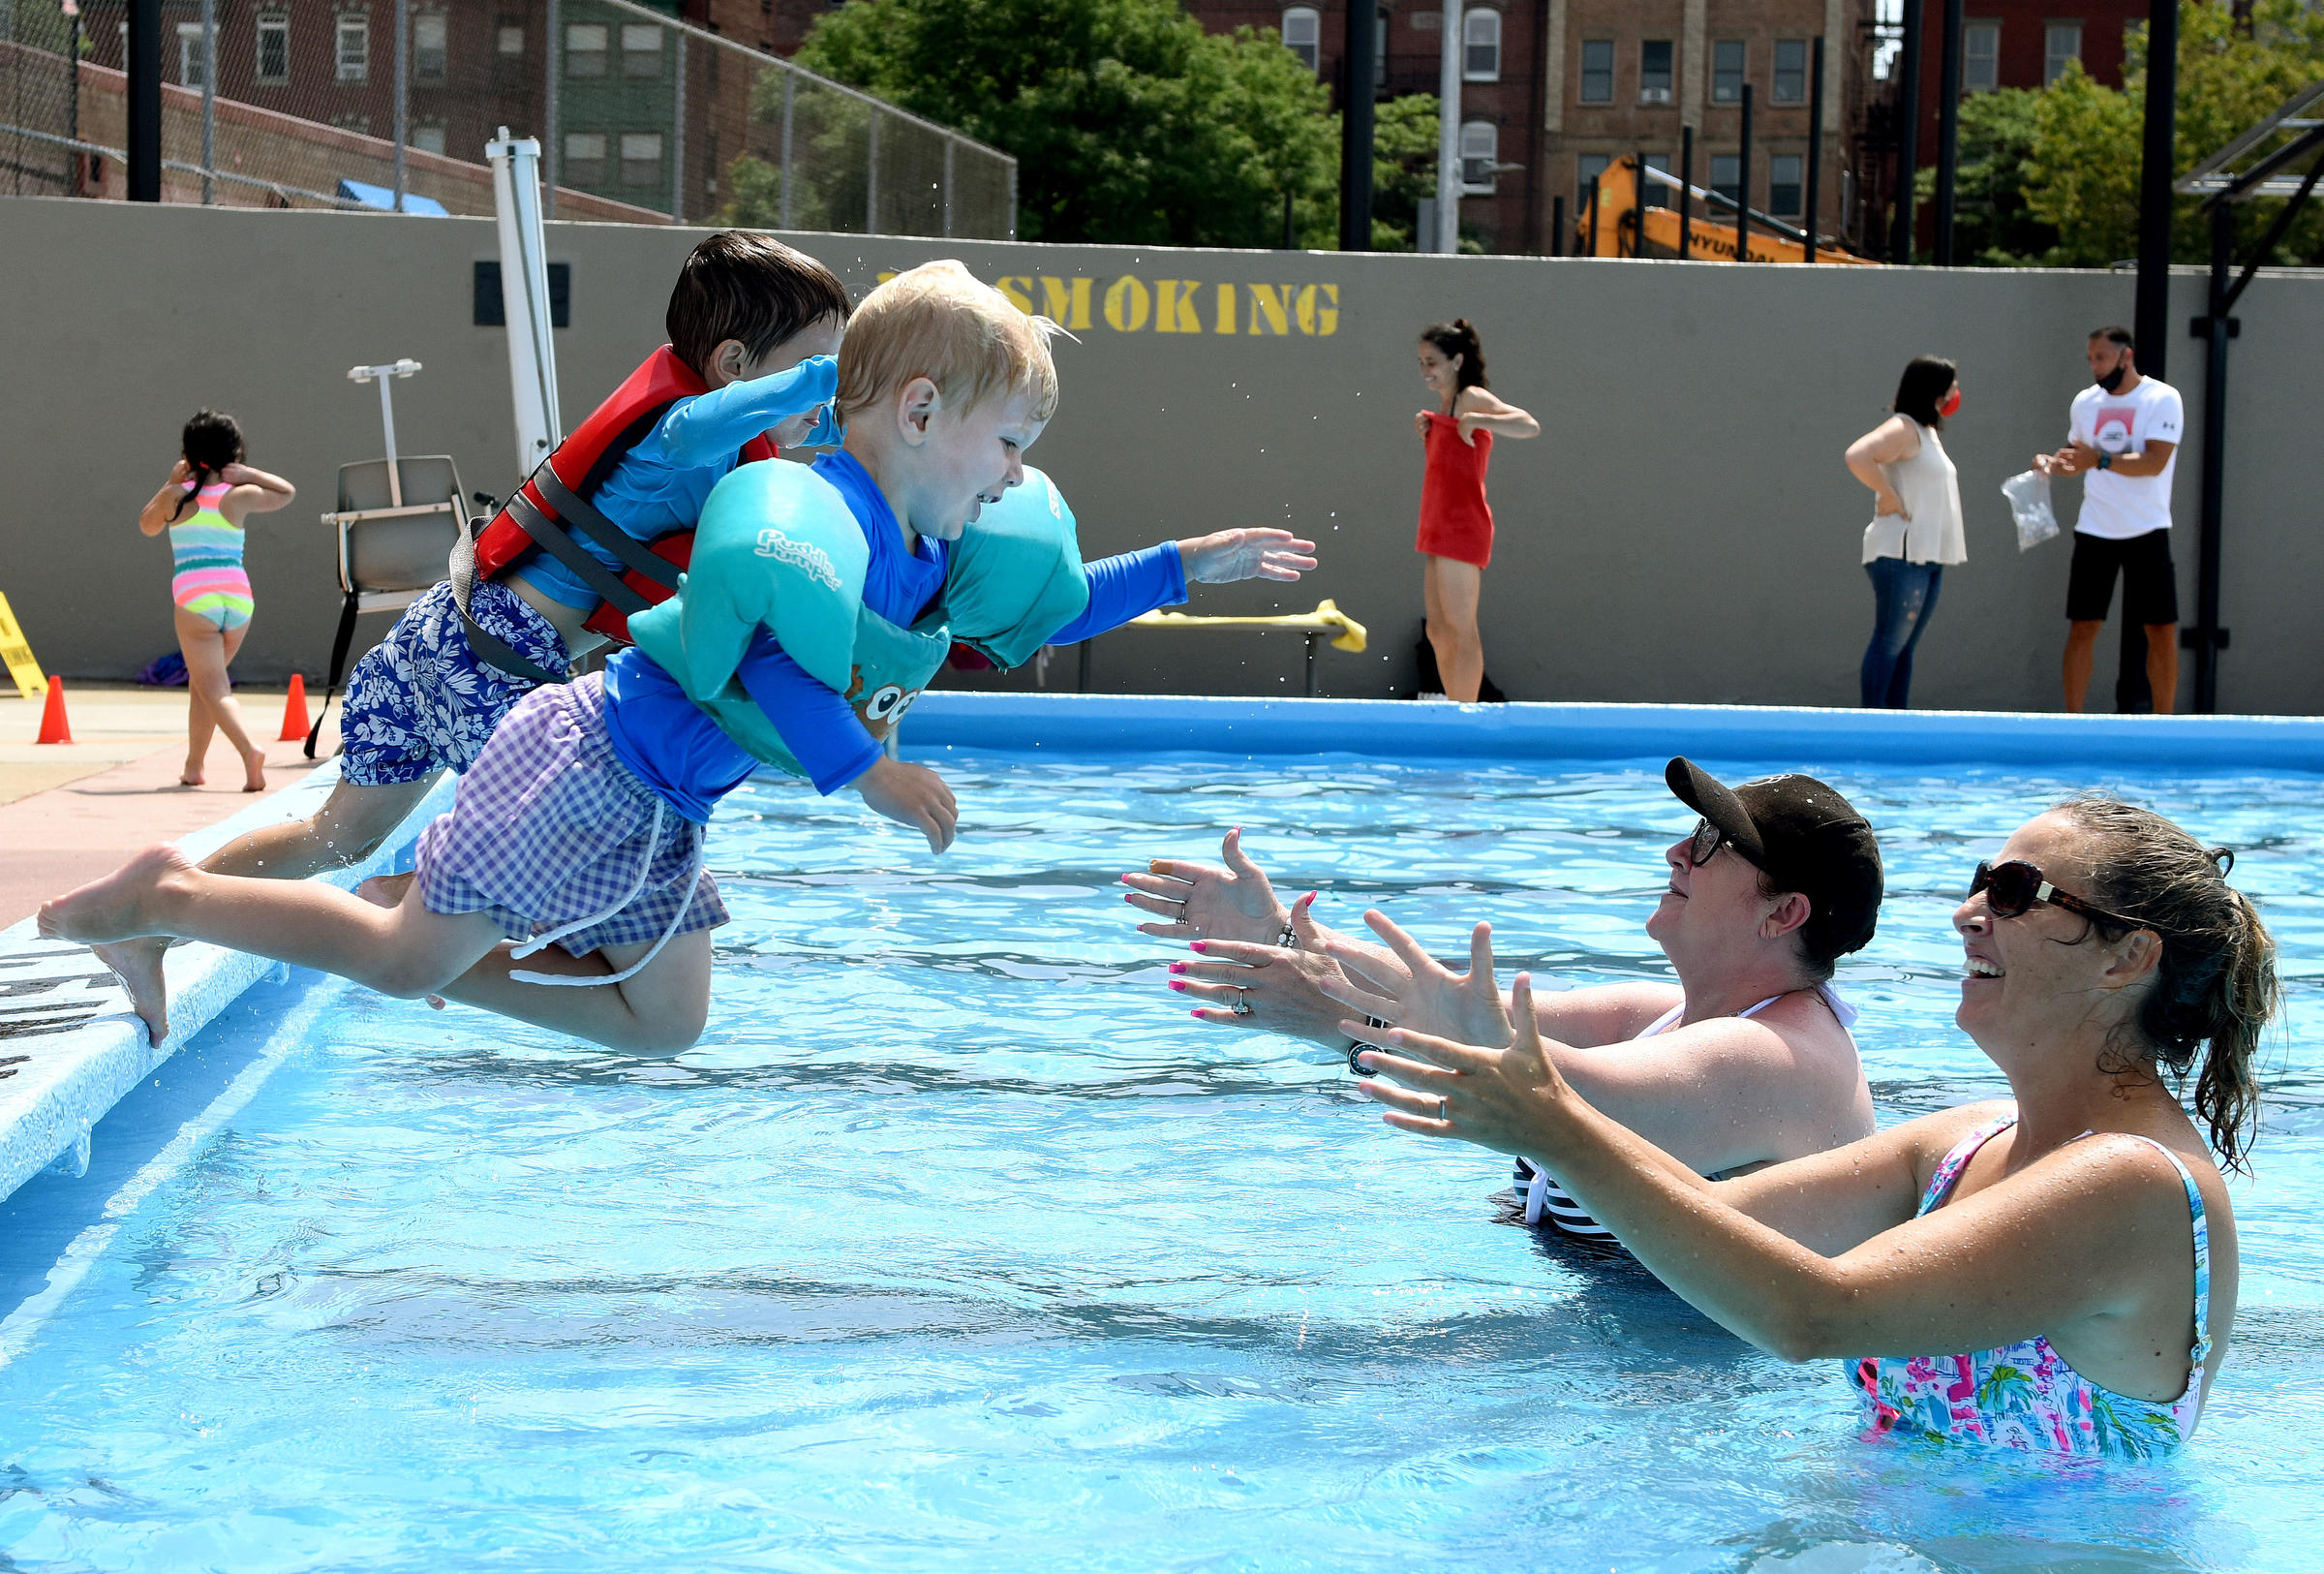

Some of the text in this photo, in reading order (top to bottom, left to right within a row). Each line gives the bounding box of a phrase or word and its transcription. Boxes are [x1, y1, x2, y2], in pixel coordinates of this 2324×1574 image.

[996, 275, 1338, 336] SMOKING
[754, 542, 843, 592] Jumper
[757, 530, 836, 577] Puddle
